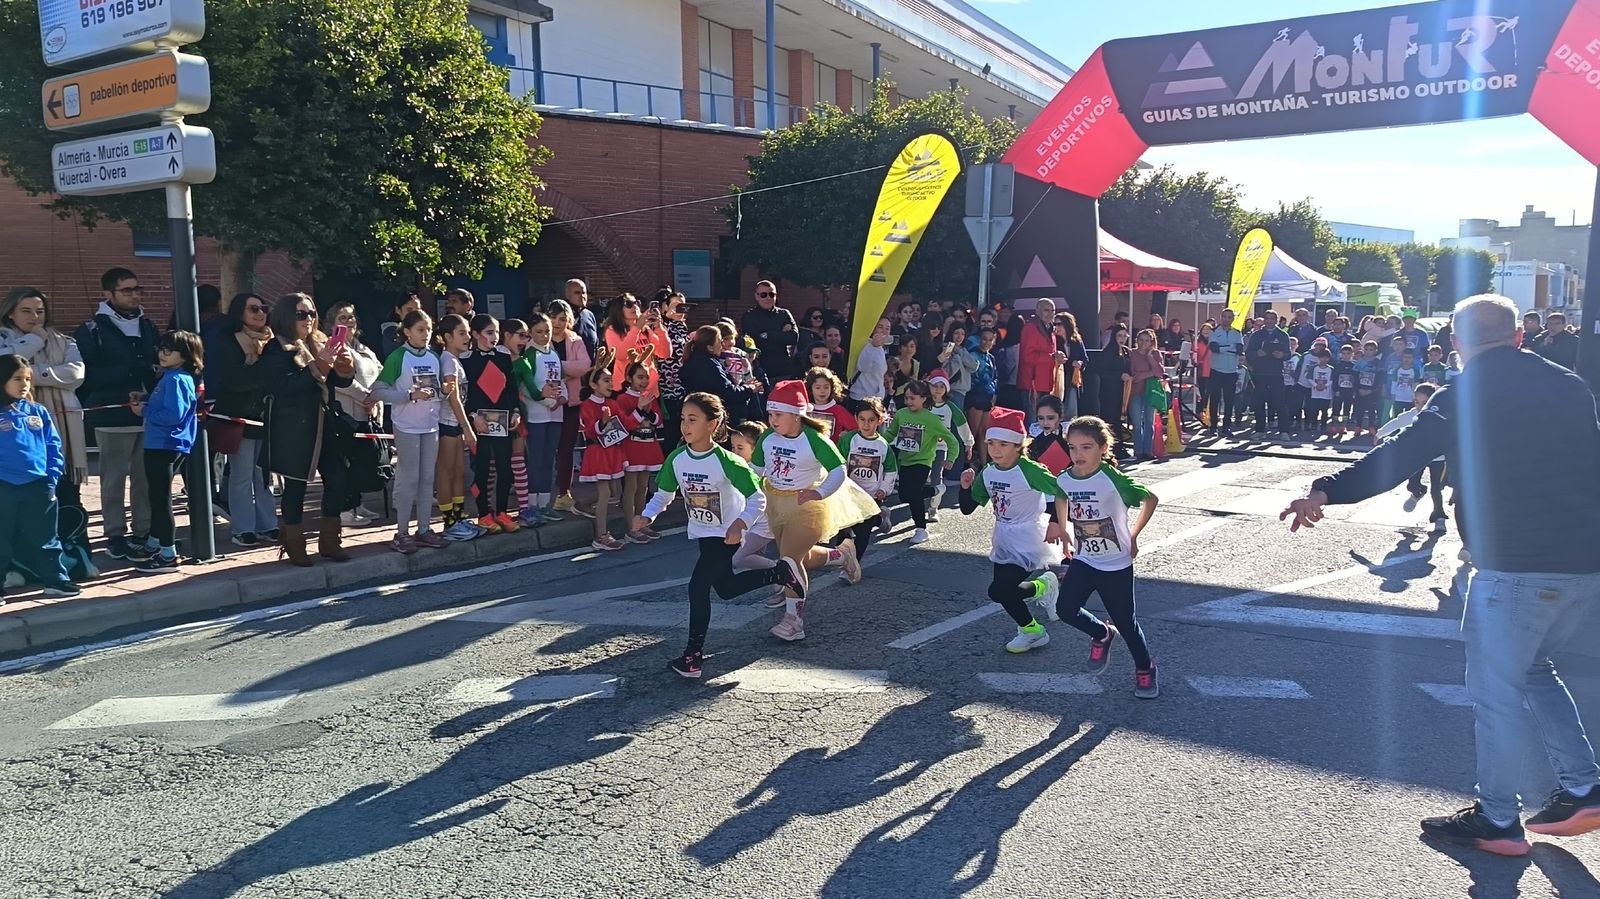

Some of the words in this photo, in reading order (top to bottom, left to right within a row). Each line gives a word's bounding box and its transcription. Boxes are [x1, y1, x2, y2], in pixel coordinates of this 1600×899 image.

[81, 7, 105, 28] 619
[109, 0, 134, 19] 196
[1554, 44, 1600, 89] DEPO
[90, 82, 129, 105] pabellón
[131, 72, 177, 94] deportivo
[1142, 107, 1193, 124] GUIAS
[1196, 105, 1219, 119] DE
[1222, 94, 1309, 117] MONTAÑA
[1322, 85, 1411, 106] TURISMO
[1414, 74, 1518, 97] OUTDOOR
[1036, 95, 1092, 156] EVENTOS
[151, 138, 162, 150] A-7
[1036, 95, 1113, 178] DEPORTIVOS
[98, 142, 129, 160] Murcia
[59, 168, 92, 186] Huercal
[99, 166, 127, 181] Overa
[489, 423, 502, 433] 34
[604, 430, 621, 443] 367
[901, 438, 917, 449] 382
[854, 468, 873, 479] 400
[691, 508, 713, 523] 379
[1082, 538, 1108, 553] 381
